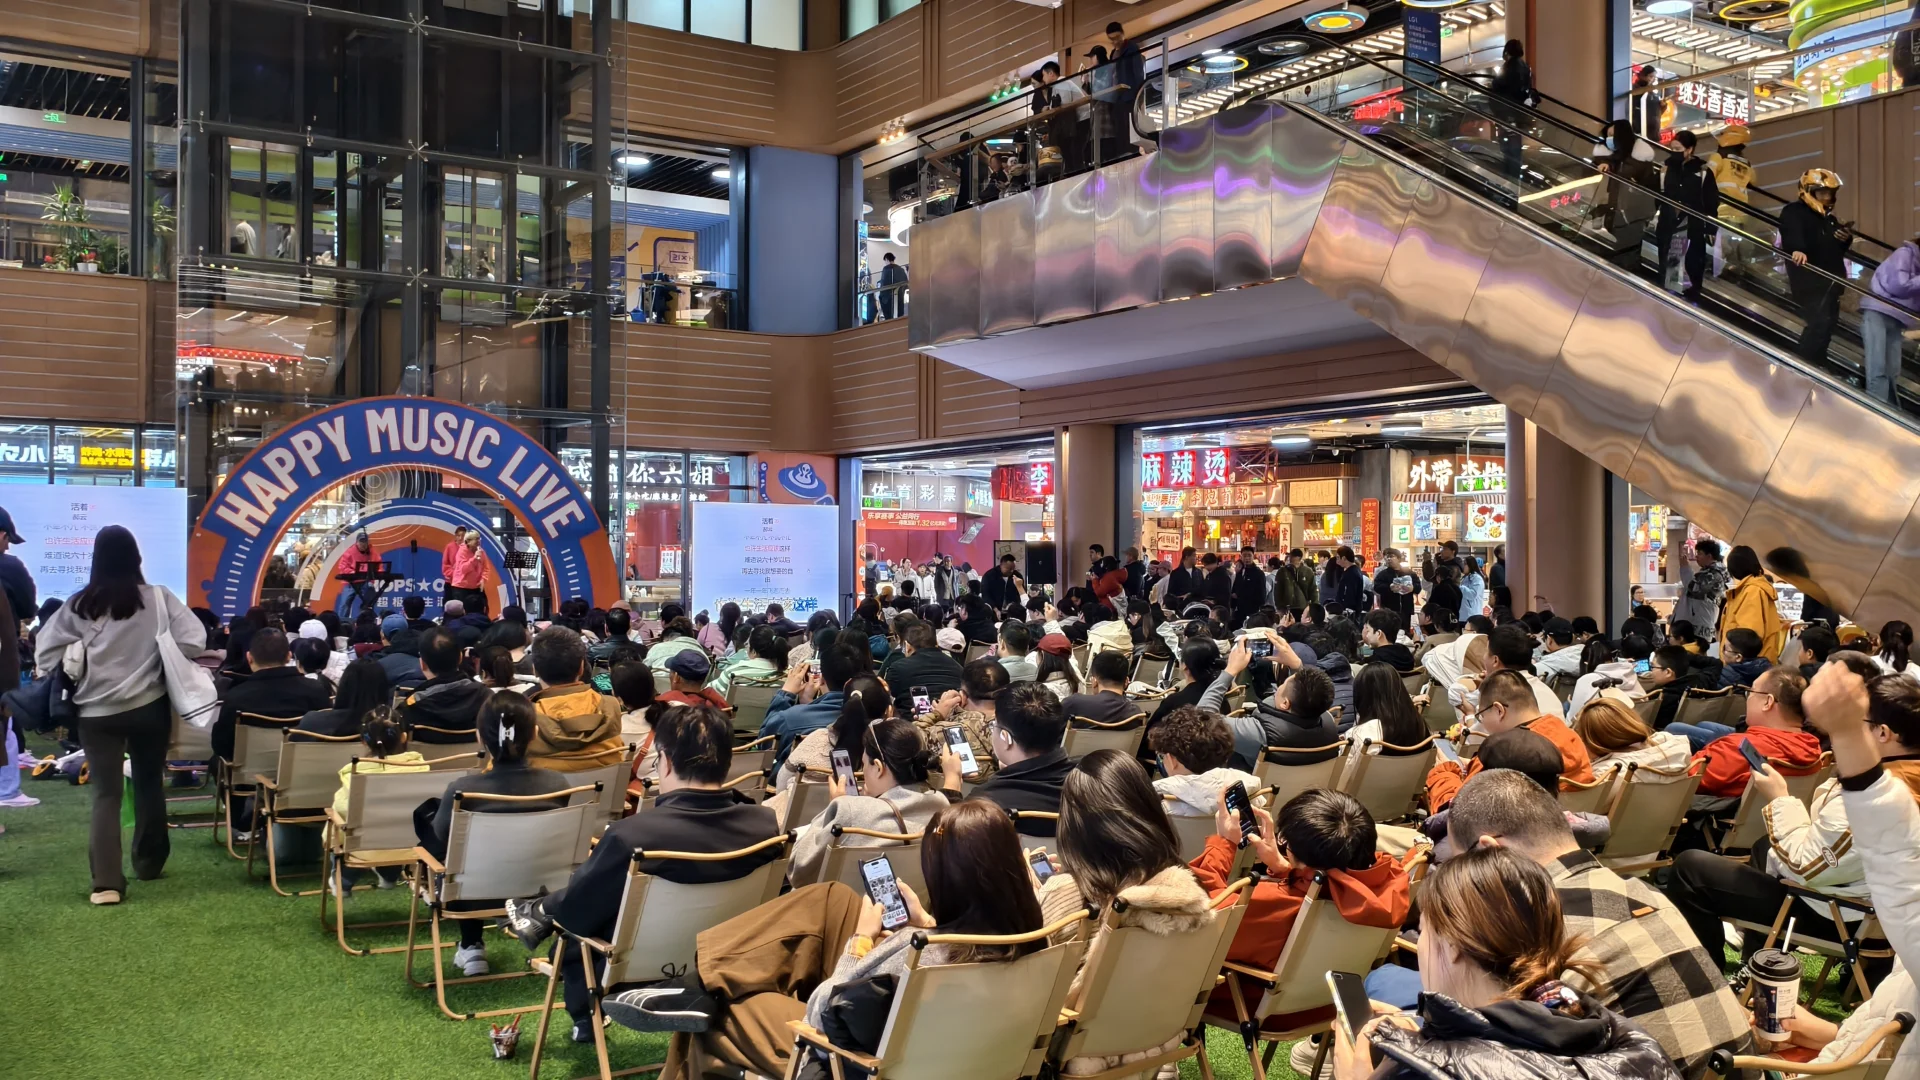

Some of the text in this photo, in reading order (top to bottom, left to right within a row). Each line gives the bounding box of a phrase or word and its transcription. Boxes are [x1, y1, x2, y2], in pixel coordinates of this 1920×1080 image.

[216, 407, 586, 538] HAPPY MUSIC LIVE
[1142, 449, 1226, 487] 麻辣烫
[1408, 459, 1453, 491] 外带
[71, 502, 89, 511] 活着
[871, 483, 957, 501] 体育彩票
